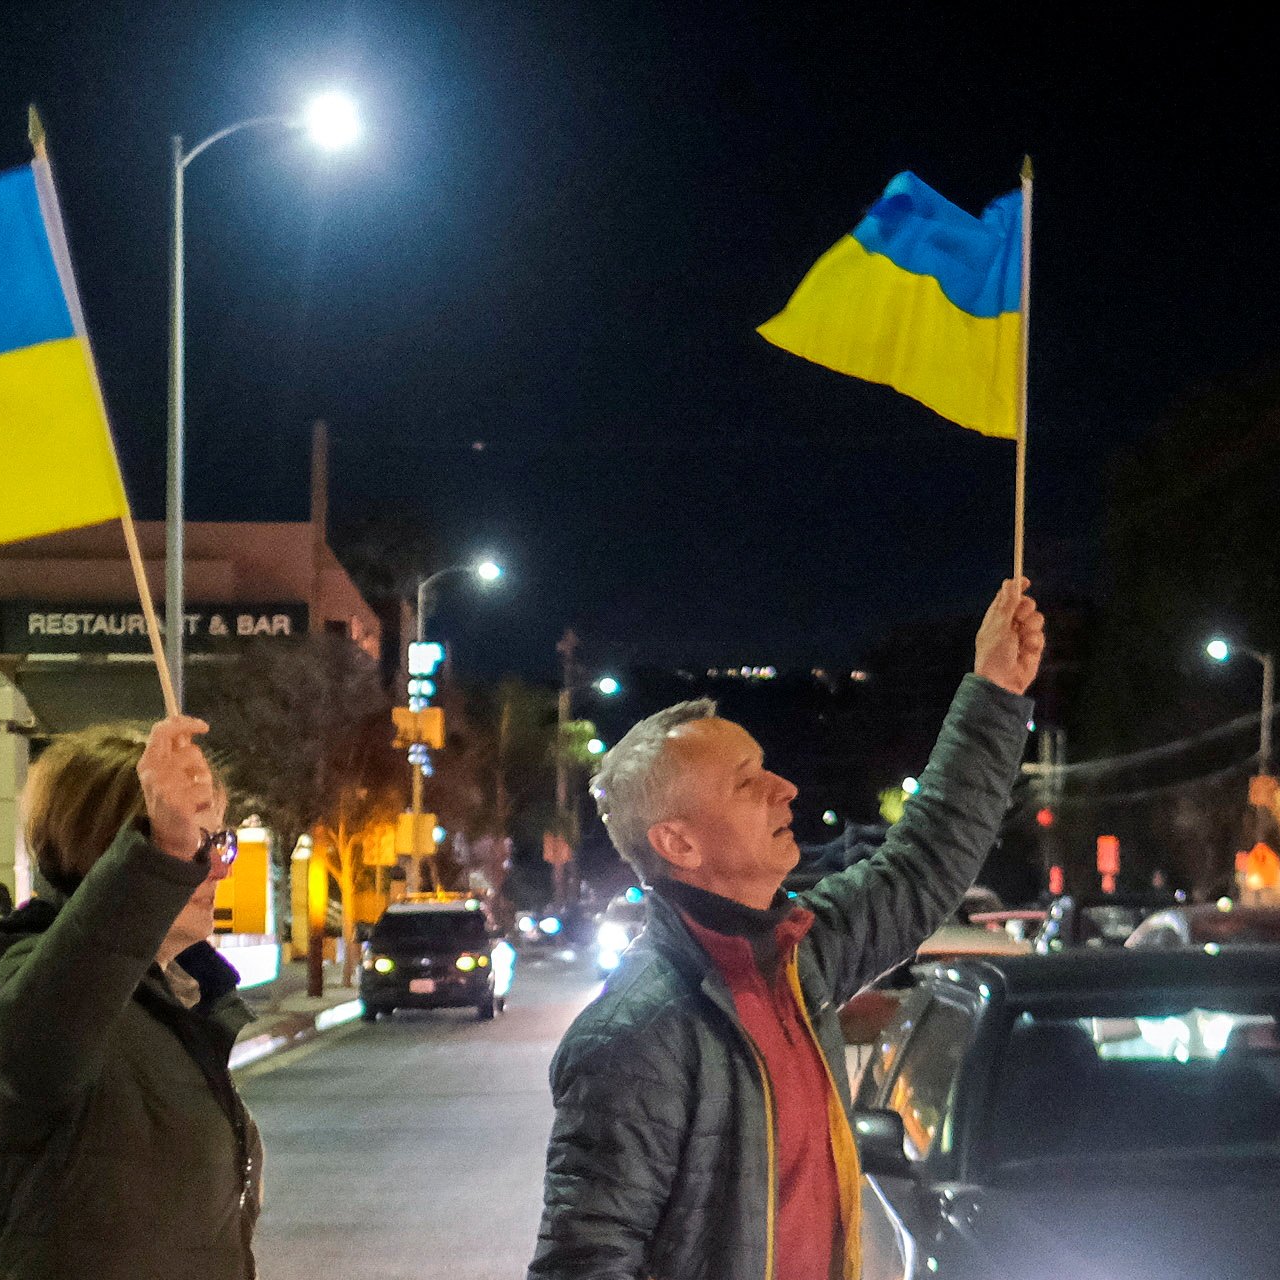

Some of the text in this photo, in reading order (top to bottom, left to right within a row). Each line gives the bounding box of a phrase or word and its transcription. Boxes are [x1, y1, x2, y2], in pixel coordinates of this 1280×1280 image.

[27, 613, 290, 636] RESTAURT & BAR
